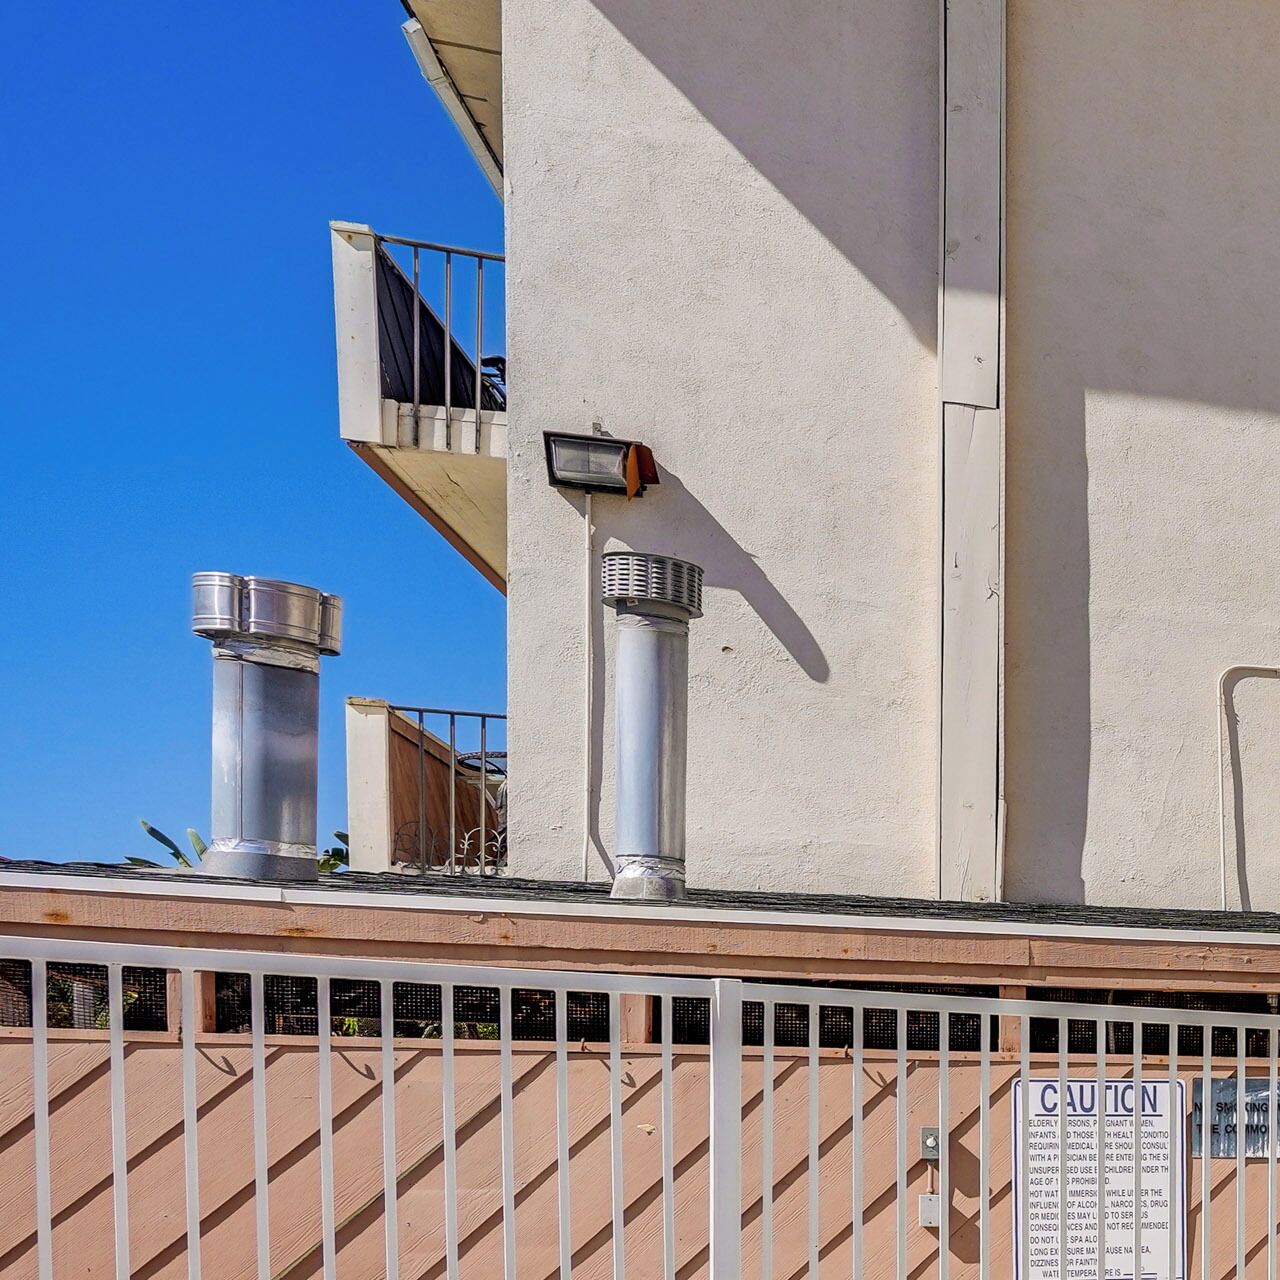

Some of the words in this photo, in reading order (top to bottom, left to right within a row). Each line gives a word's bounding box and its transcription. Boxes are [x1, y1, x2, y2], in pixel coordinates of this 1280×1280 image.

[1040, 1083, 1158, 1114] CAUTION
[1028, 1119, 1058, 1128] ELDERLY
[1093, 1119, 1128, 1128] PGNANT
[1196, 1124, 1219, 1134] TE
[1028, 1131, 1057, 1139] INFANTS
[1073, 1131, 1094, 1139] THOSE
[1113, 1131, 1133, 1139] HEALT
[1140, 1131, 1169, 1139] CONDITIO
[1029, 1142, 1060, 1150] REQUIRIN
[1030, 1154, 1046, 1162] WITH
[1047, 1154, 1052, 1162] A
[1089, 1153, 1114, 1162] BERE
[1149, 1153, 1161, 1161] THE
[1029, 1166, 1079, 1174] UNSUPERSED
[1080, 1166, 1093, 1174] USE
[1142, 1166, 1159, 1174] NDER
[1030, 1178, 1043, 1186] AGE
[1029, 1190, 1043, 1198] HOT
[1106, 1189, 1126, 1197] WHILE
[1150, 1200, 1169, 1208] DRUG
[1030, 1212, 1040, 1220] OR
[1084, 1223, 1097, 1231] AND
[1106, 1222, 1120, 1230] NOT
[1030, 1236, 1040, 1244] DO
[1041, 1236, 1054, 1244] NOT
[1070, 1236, 1083, 1244] SPA
[1030, 1248, 1048, 1256] LONG
[1049, 1247, 1085, 1256] EXSURE
[1105, 1246, 1122, 1254] AUSE
[1030, 1259, 1059, 1267] DIZZINES
[1042, 1270, 1059, 1278] WATE
[1067, 1269, 1114, 1278] TEMPERARE
[1114, 1268, 1121, 1276] IS
